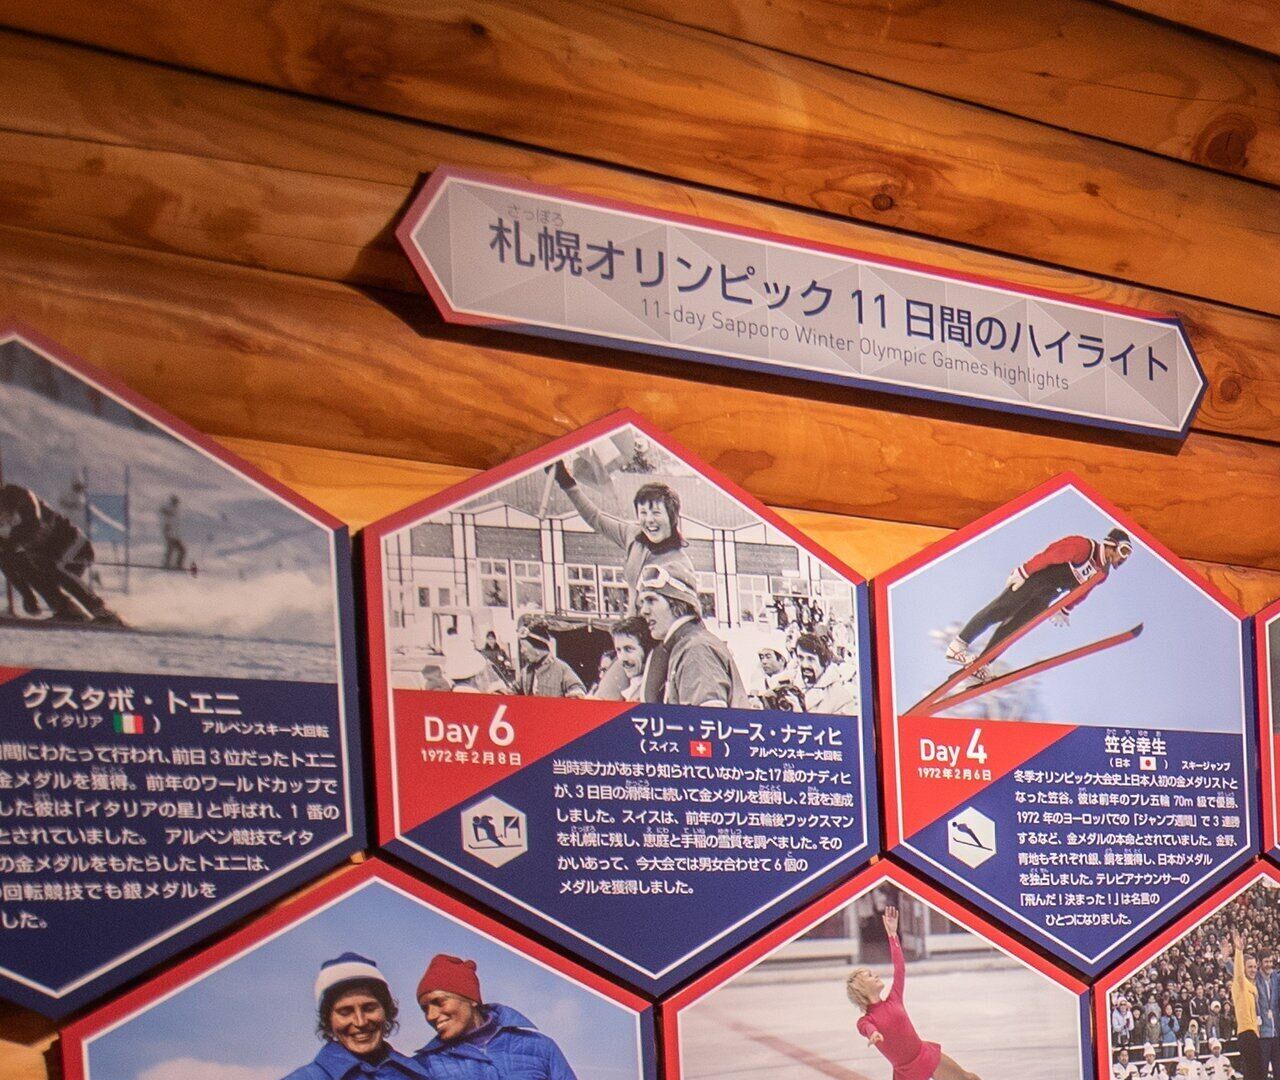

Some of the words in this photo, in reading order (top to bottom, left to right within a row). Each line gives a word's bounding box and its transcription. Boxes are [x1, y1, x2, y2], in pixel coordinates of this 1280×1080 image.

[507, 203, 565, 226] さっぽろ
[640, 299, 707, 331] 11-day
[711, 308, 791, 345] Sapporo
[794, 325, 855, 355] Winter
[859, 337, 927, 368] Olympic
[933, 350, 989, 377] Games
[993, 361, 1070, 391] highlights
[22, 683, 243, 716] グスタボ・トエニ
[200, 720, 330, 739] アルペンスキー大回転
[424, 716, 480, 749] Day
[489, 704, 516, 748] 6
[631, 716, 844, 746] マリー・テレース・ナディヒ
[0, 744, 337, 768] 間にわたって行われ、前日3位だったトエニ
[748, 746, 843, 763] アルペンスキー大回転
[919, 738, 961, 769] Day
[966, 728, 988, 765] 4
[1104, 735, 1168, 757] 笠谷幸生
[1181, 760, 1231, 772] スキージャンプ
[0, 880, 217, 901] 回転競技でも銀メダルを
[559, 880, 694, 895] メダルを獲得しました。
[1045, 913, 1132, 927] ひとつになりました。
